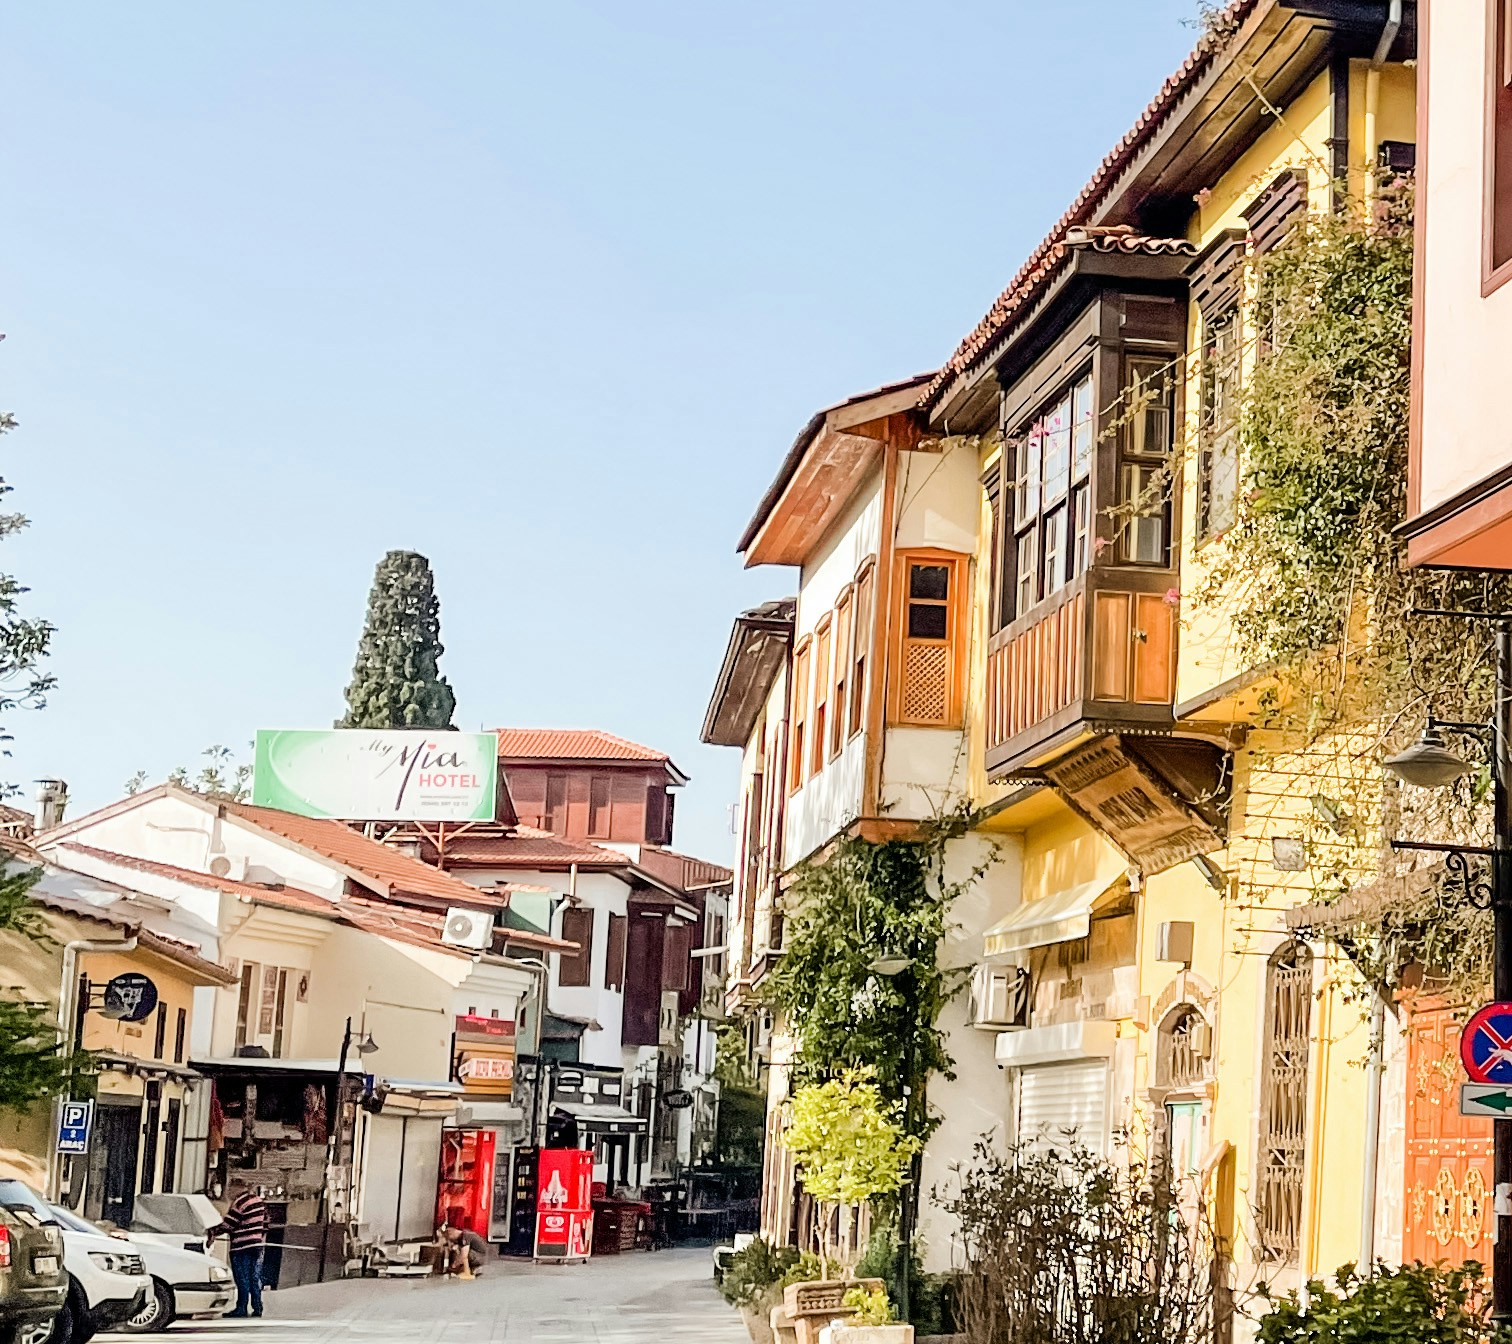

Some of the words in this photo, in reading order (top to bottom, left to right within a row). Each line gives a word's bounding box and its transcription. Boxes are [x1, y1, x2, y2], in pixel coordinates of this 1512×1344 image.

[375, 739, 464, 811] Mia
[419, 773, 481, 788] HOTEL
[68, 1108, 82, 1125] P
